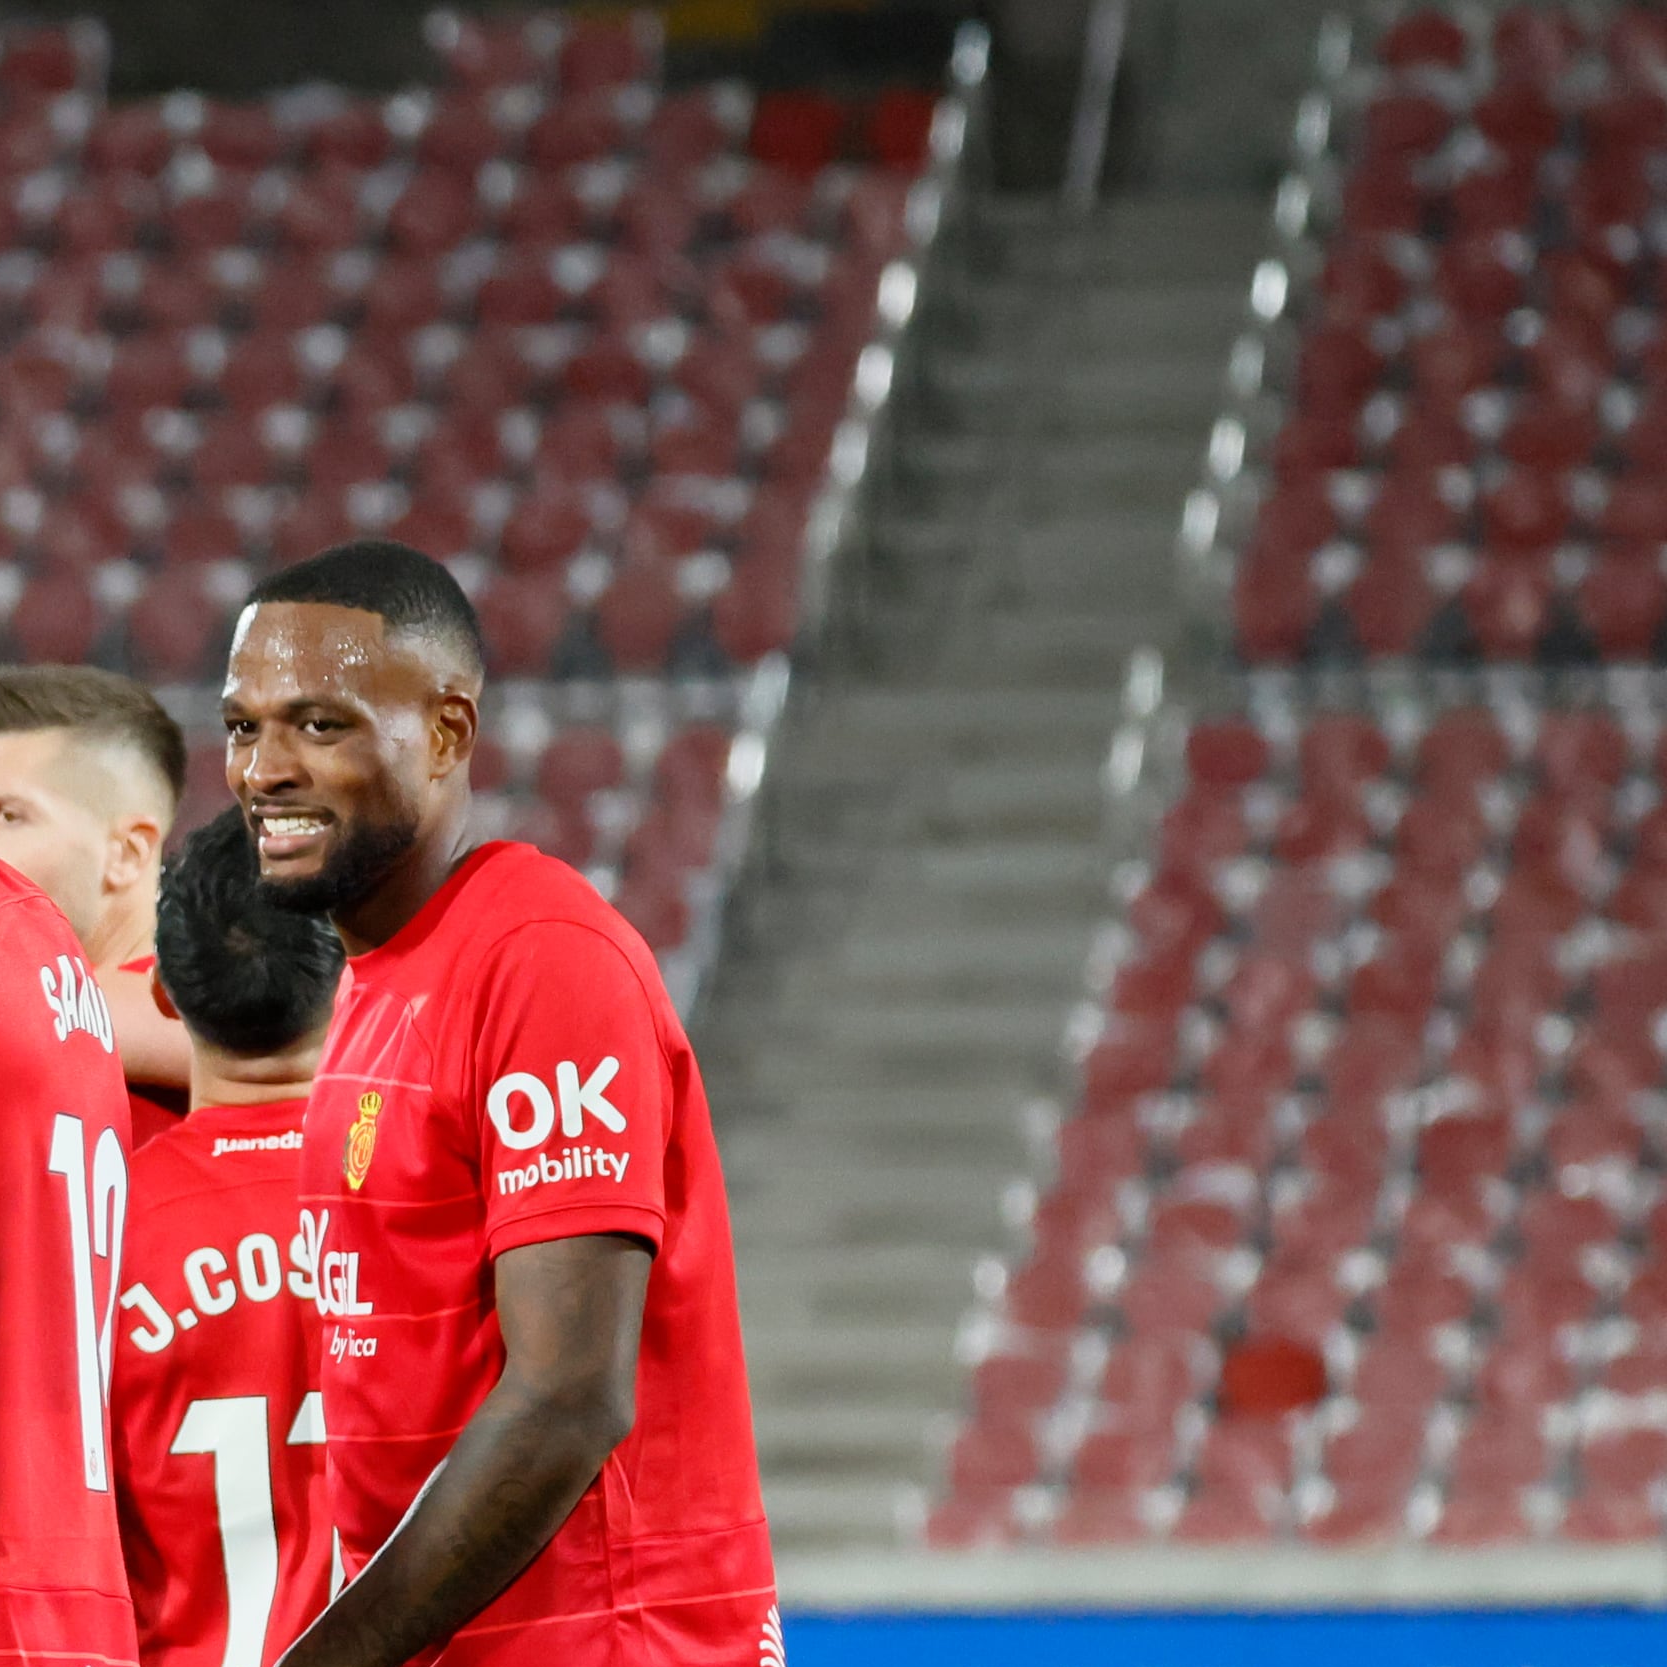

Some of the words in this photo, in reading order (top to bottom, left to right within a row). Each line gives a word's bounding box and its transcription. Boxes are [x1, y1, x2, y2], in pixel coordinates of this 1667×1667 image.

[487, 1056, 627, 1150] OK
[498, 1145, 630, 1195] mobility
[122, 1232, 317, 1353] J.COS
